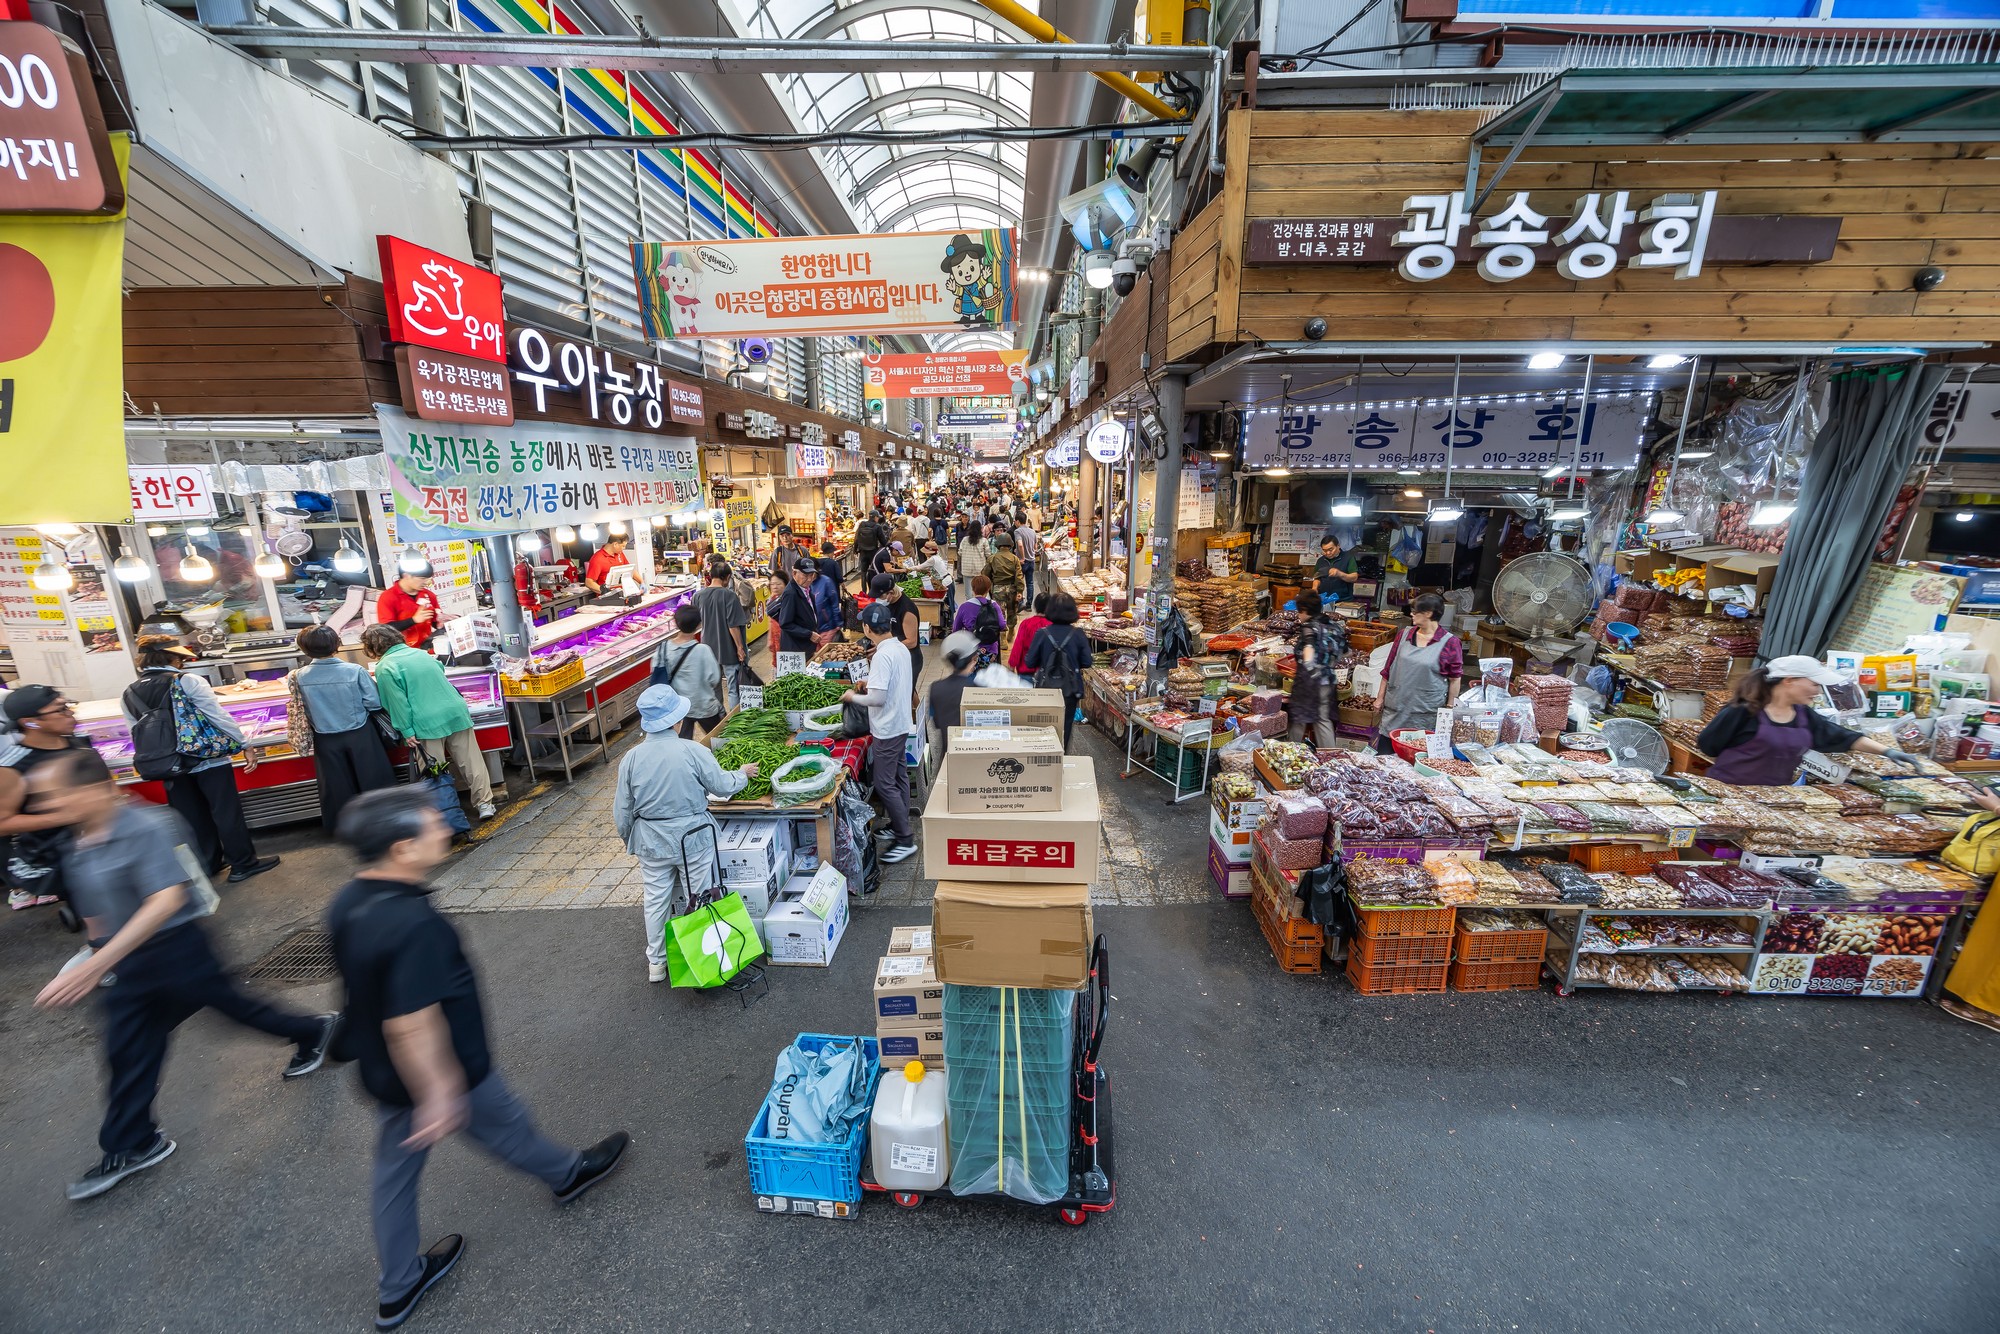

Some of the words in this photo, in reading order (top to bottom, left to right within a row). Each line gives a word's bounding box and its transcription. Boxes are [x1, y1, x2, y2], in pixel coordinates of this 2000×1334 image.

[1273, 223, 1349, 239] 건강식품.견과류
[1353, 222, 1374, 238] 일체
[1393, 190, 1718, 282] 광송상회
[700, 251, 729, 270] 안녕하세요!
[780, 252, 871, 279] 환영합니다
[463, 315, 503, 356] 우아
[417, 359, 503, 391] 육가공전문업체
[516, 328, 664, 429] 우아농장
[870, 370, 883, 383] 경
[888, 367, 912, 376] 서울시
[913, 366, 937, 375] 디자인
[938, 366, 954, 374] 혁신
[956, 365, 986, 373] 전통시장
[988, 363, 1005, 372] 조성
[922, 374, 954, 383] 공모사업
[955, 374, 971, 382] 선정
[1010, 363, 1023, 378] 축
[421, 388, 508, 417] 한우.한돈.부산물
[408, 432, 501, 476] 산지직송
[510, 440, 583, 472] 농장에서
[588, 443, 617, 470] 바로
[620, 445, 654, 473] 우리집
[657, 449, 694, 473] 식탁으로
[1378, 453, 1445, 463] 966-4873
[1482, 452, 1605, 463] 010-3285-7511
[420, 485, 469, 525] 직접
[478, 481, 600, 521] 생산,가공하여
[604, 481, 652, 507] 도매가로
[726, 500, 754, 519] 홍어회무침
[448, 542, 466, 551] 10,000
[956, 843, 1067, 864] 취급주의
[1769, 976, 1909, 991] 010-3285-7511
